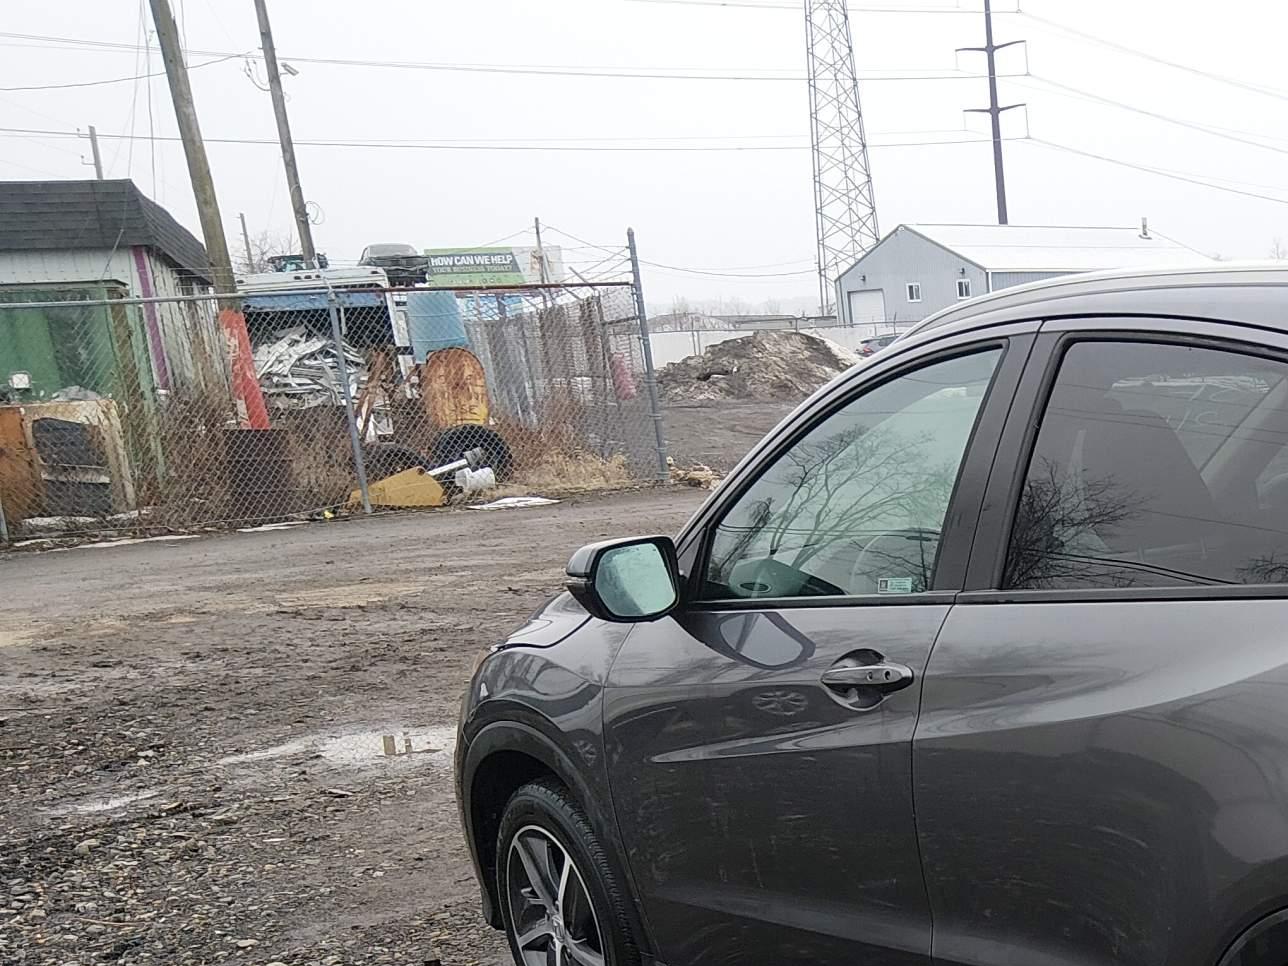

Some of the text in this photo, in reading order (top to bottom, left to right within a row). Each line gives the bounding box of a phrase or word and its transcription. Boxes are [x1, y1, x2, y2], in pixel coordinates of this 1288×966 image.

[430, 254, 513, 266] HOW CAN WE HELP
